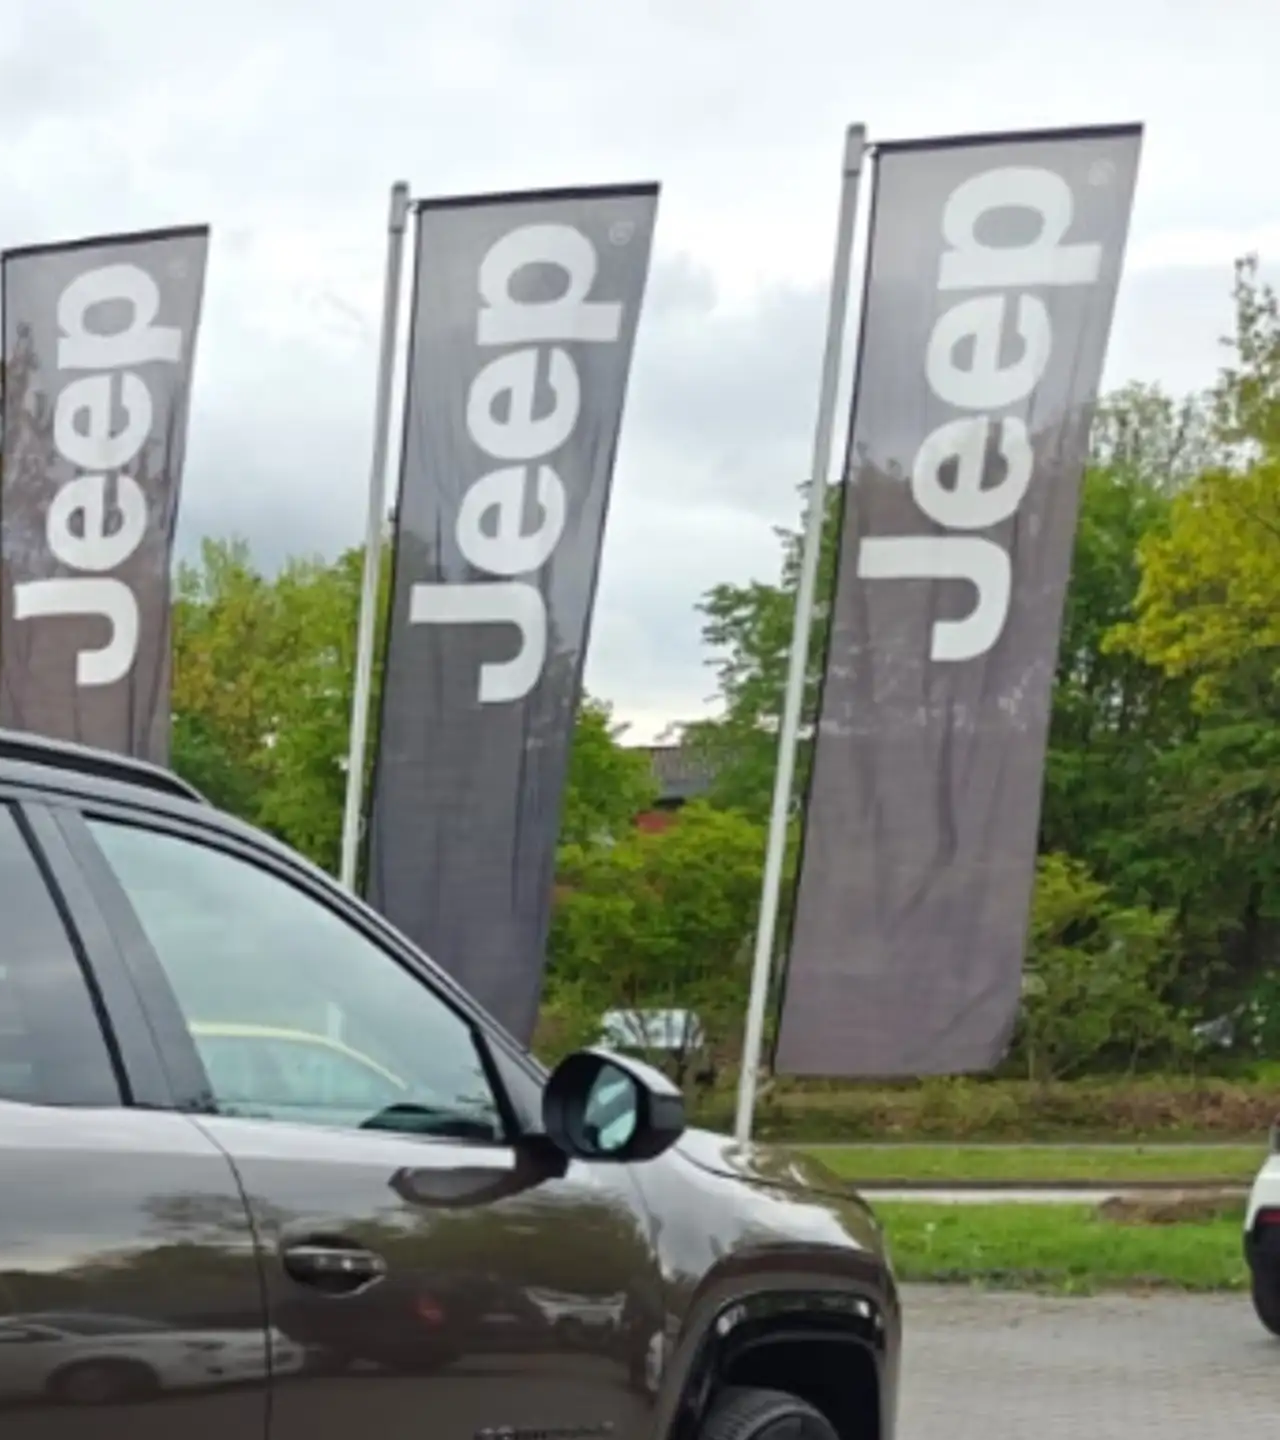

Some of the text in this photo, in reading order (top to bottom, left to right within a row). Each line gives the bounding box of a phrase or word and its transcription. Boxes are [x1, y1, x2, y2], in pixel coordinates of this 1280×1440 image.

[14, 261, 182, 686] Jeep
[410, 222, 624, 704] Jeep
[857, 165, 1104, 663] Jeep
